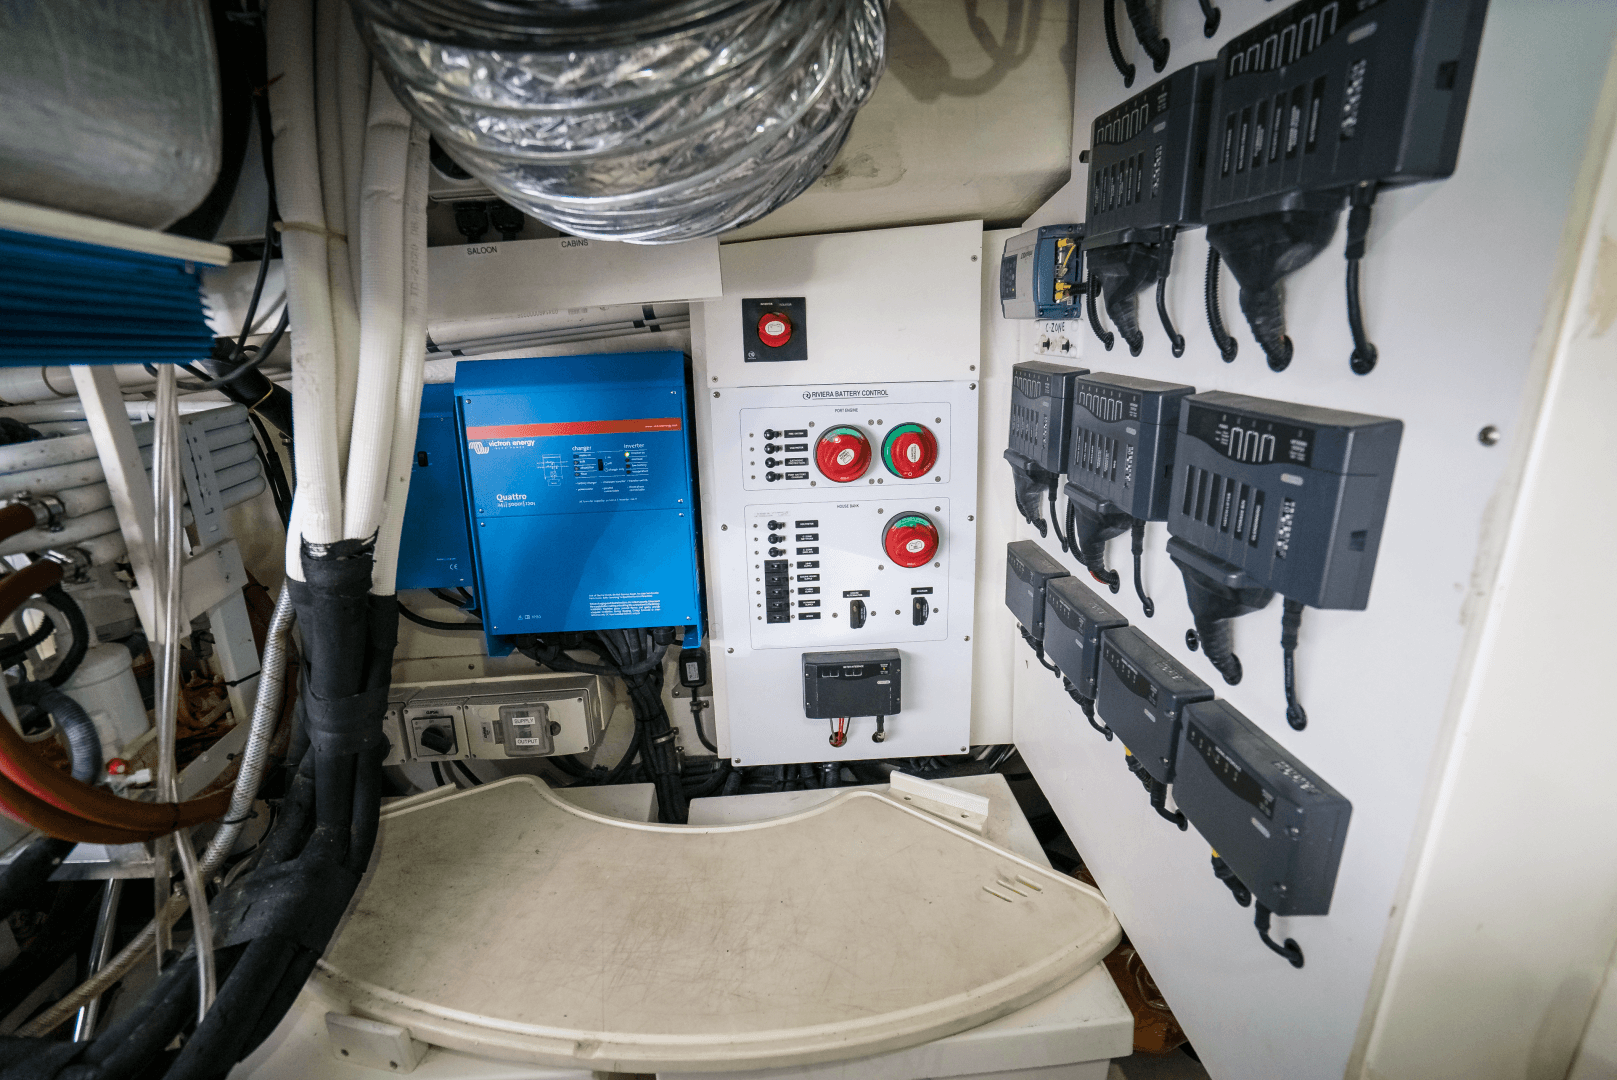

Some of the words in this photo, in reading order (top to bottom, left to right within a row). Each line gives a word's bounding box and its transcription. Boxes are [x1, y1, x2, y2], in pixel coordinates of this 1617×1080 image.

[561, 239, 589, 248] CABINS
[467, 246, 498, 255] SALOON
[496, 494, 527, 502] Quattro
